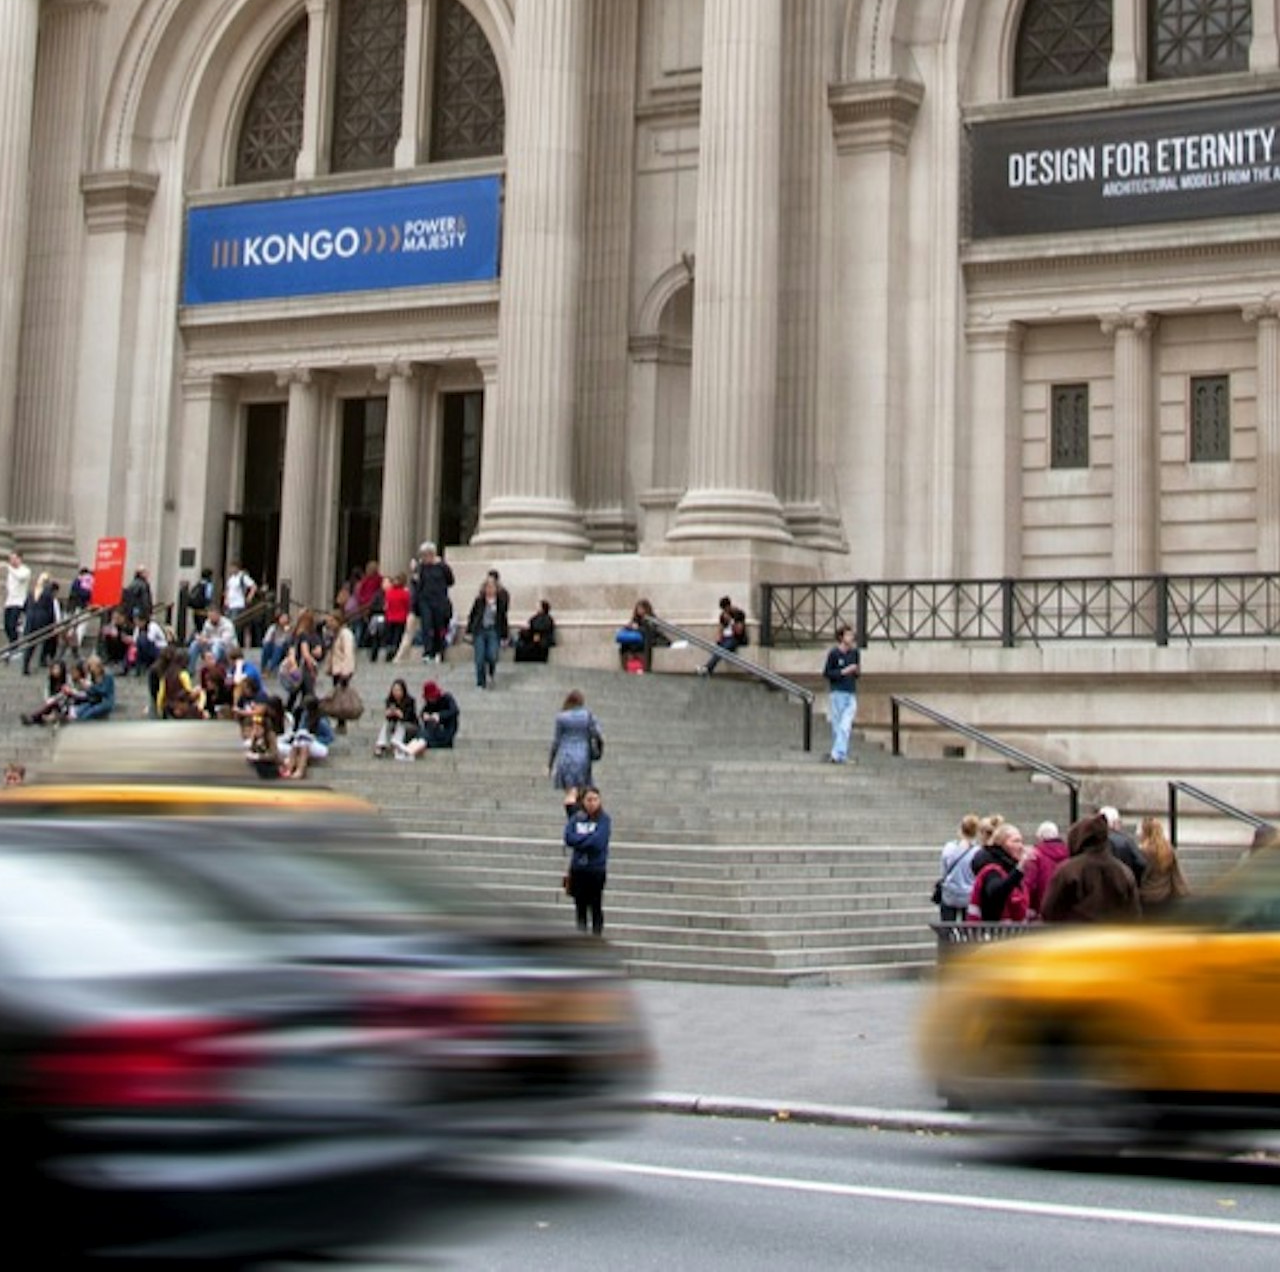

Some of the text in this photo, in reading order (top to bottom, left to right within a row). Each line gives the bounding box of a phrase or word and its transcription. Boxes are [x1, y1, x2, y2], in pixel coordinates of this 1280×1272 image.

[1009, 127, 1276, 188] DESIGN FOR ETERNITY
[1102, 176, 1179, 198] ARCHITECTURAL
[1180, 172, 1220, 190] MODELS
[1222, 169, 1250, 186] FROM
[1253, 167, 1273, 183] THE
[243, 226, 360, 267] KONGO
[402, 230, 467, 254] MAJESTY
